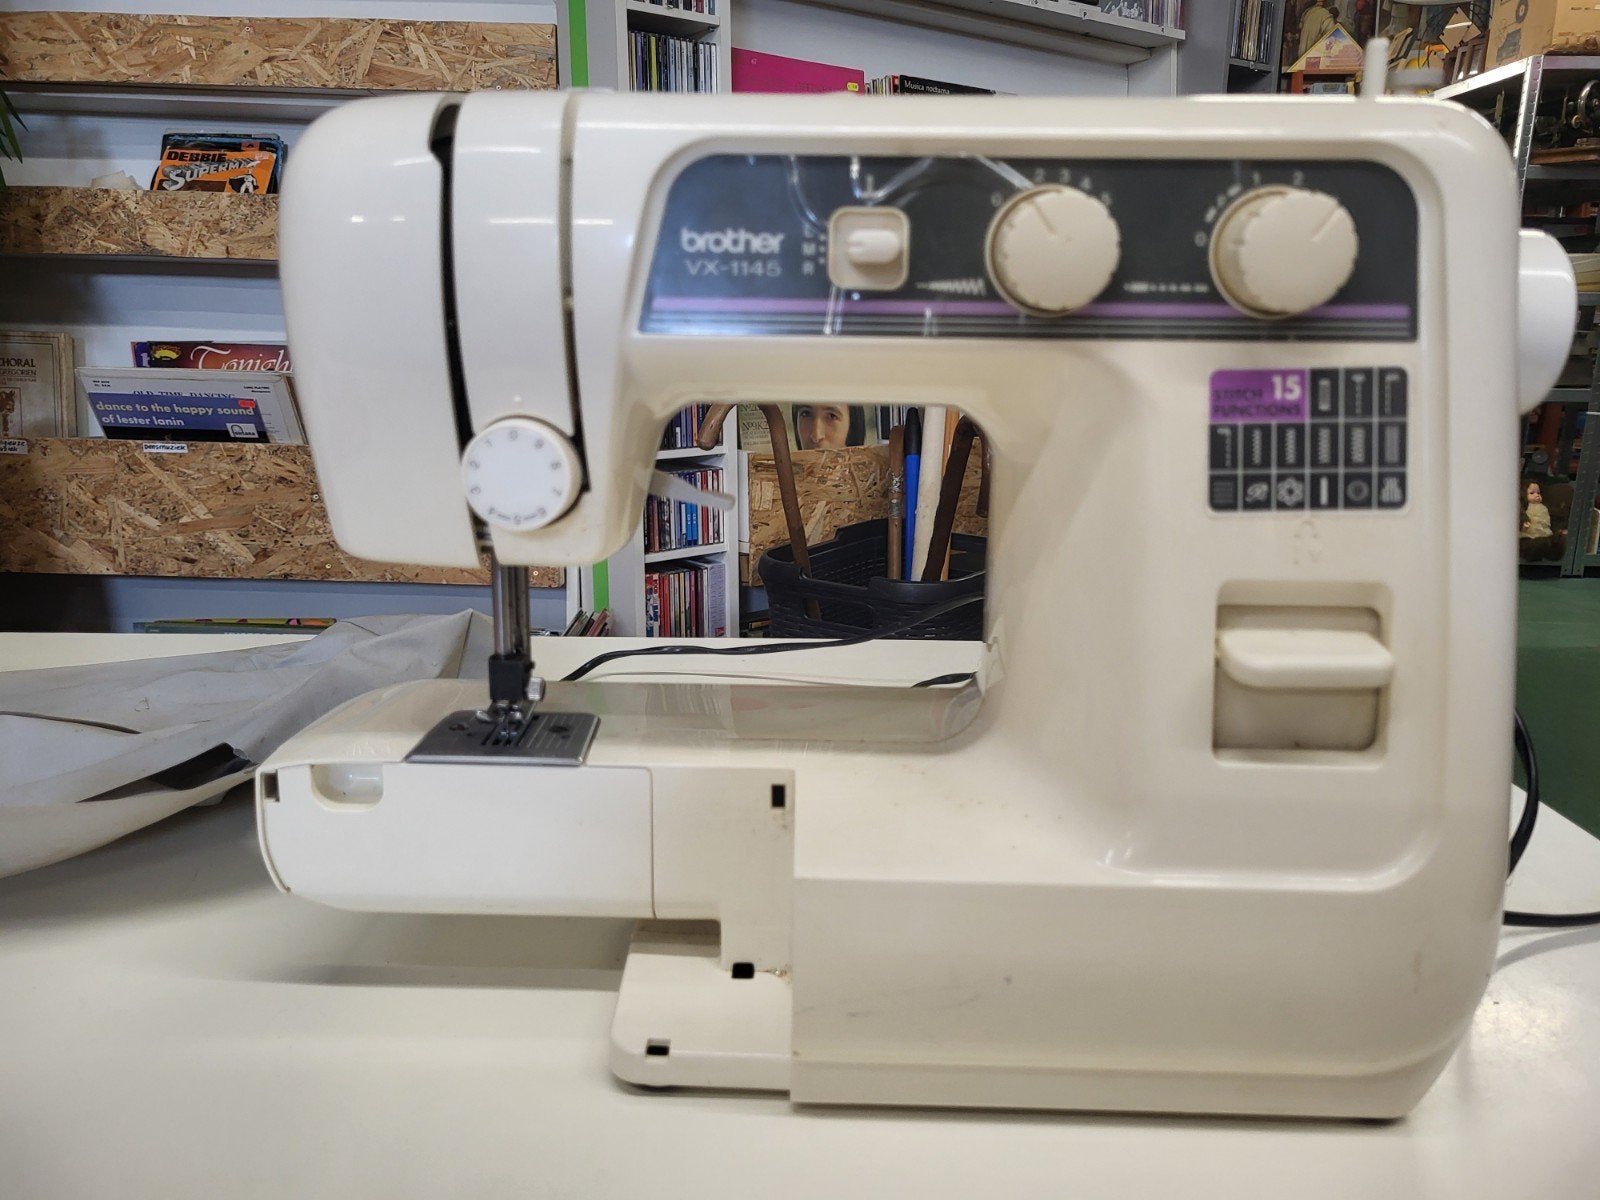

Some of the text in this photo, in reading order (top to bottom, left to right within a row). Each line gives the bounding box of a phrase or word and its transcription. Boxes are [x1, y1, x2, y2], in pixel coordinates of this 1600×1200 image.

[167, 150, 228, 162] DEBBIE
[680, 228, 785, 254] brother
[684, 259, 782, 278] VX-1145
[190, 345, 293, 373] Tonigh
[1271, 374, 1302, 401] 15
[96, 401, 255, 416] dance to the happy sound
[102, 414, 185, 426] of lester lanin
